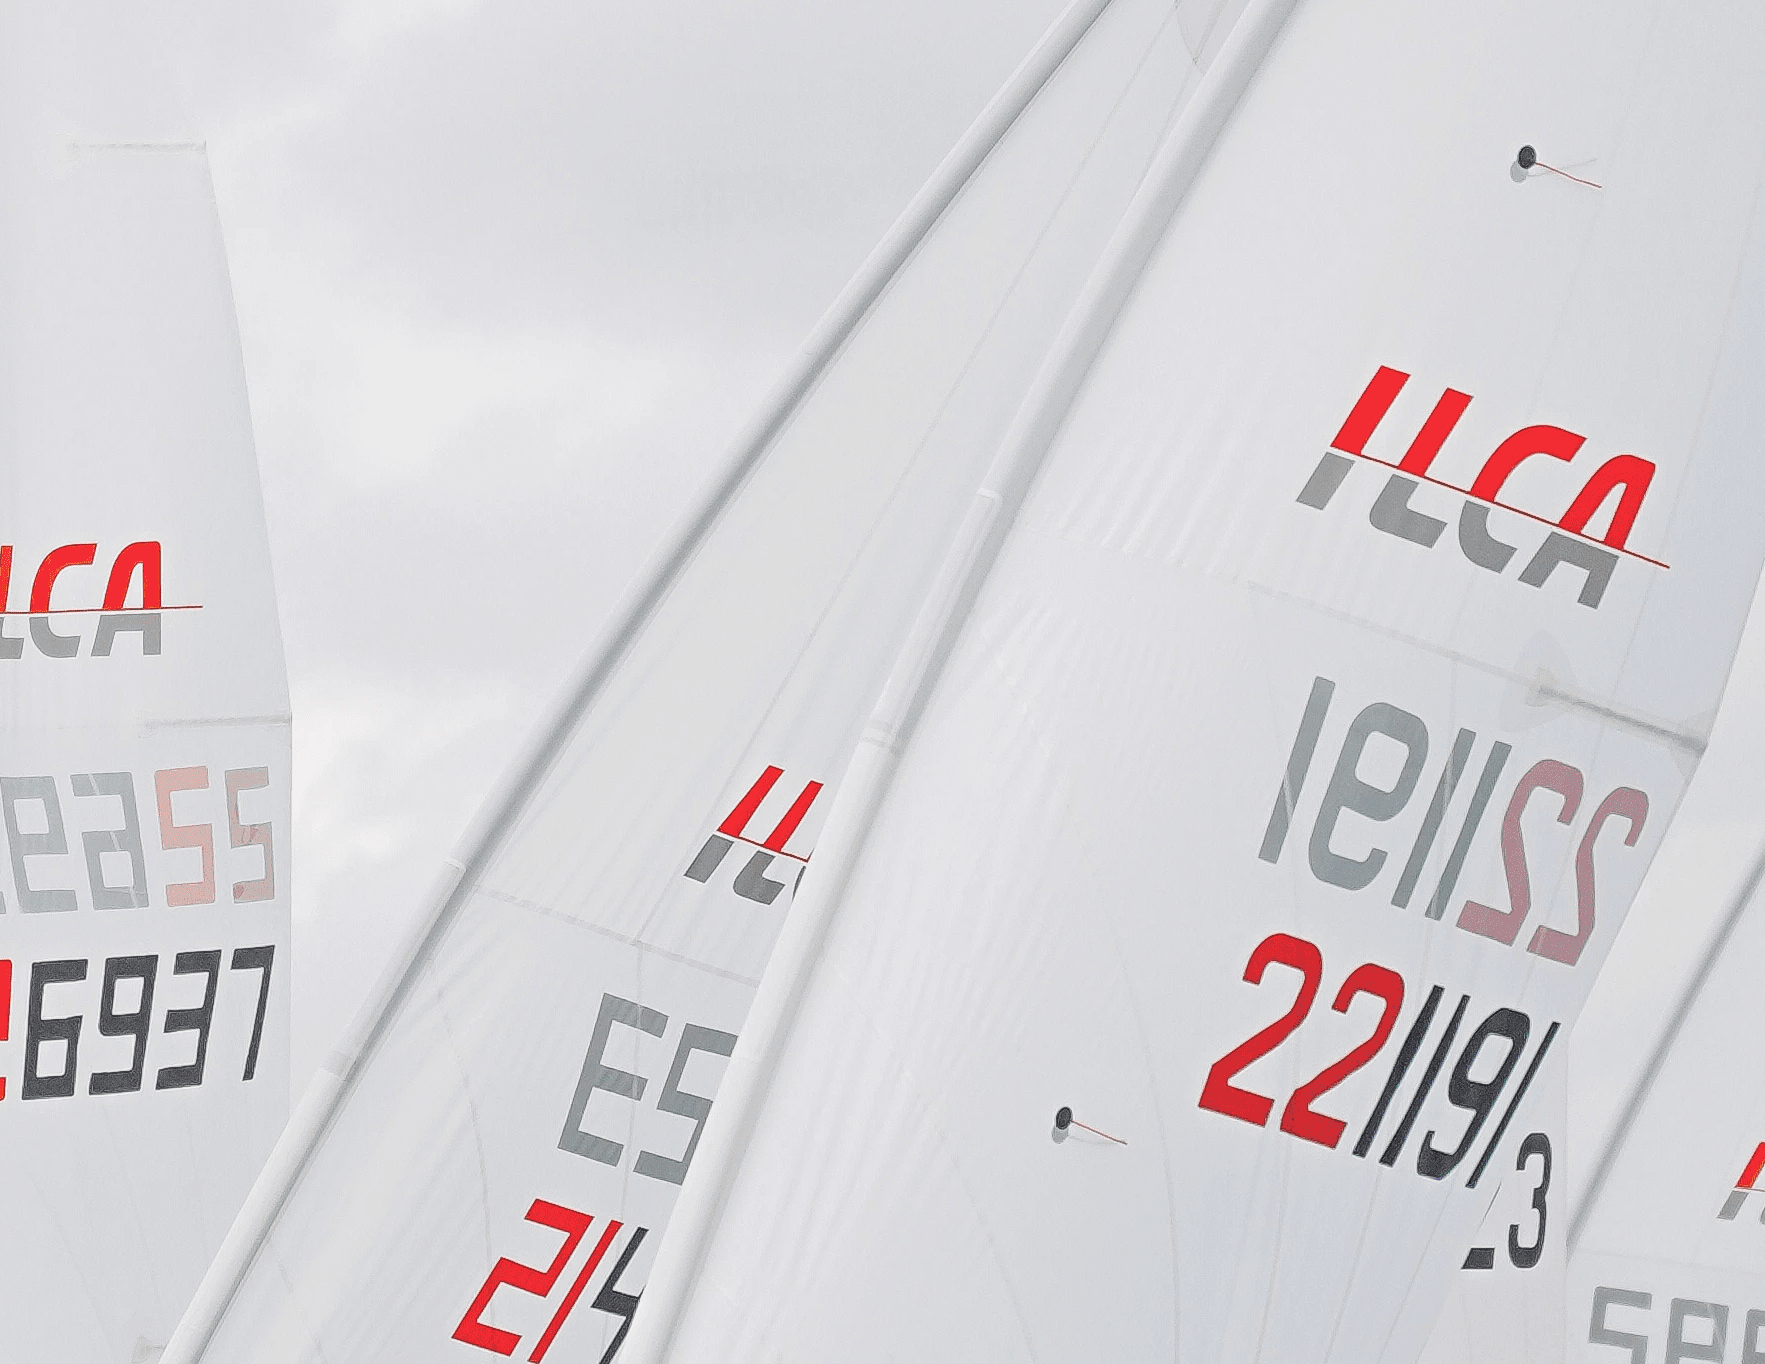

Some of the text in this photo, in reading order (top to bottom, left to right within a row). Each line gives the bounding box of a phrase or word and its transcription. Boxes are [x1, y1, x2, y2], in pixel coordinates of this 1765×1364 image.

[1296, 366, 1656, 609] ILCA
[684, 765, 824, 905] IL
[1198, 933, 1561, 1189] 221191
